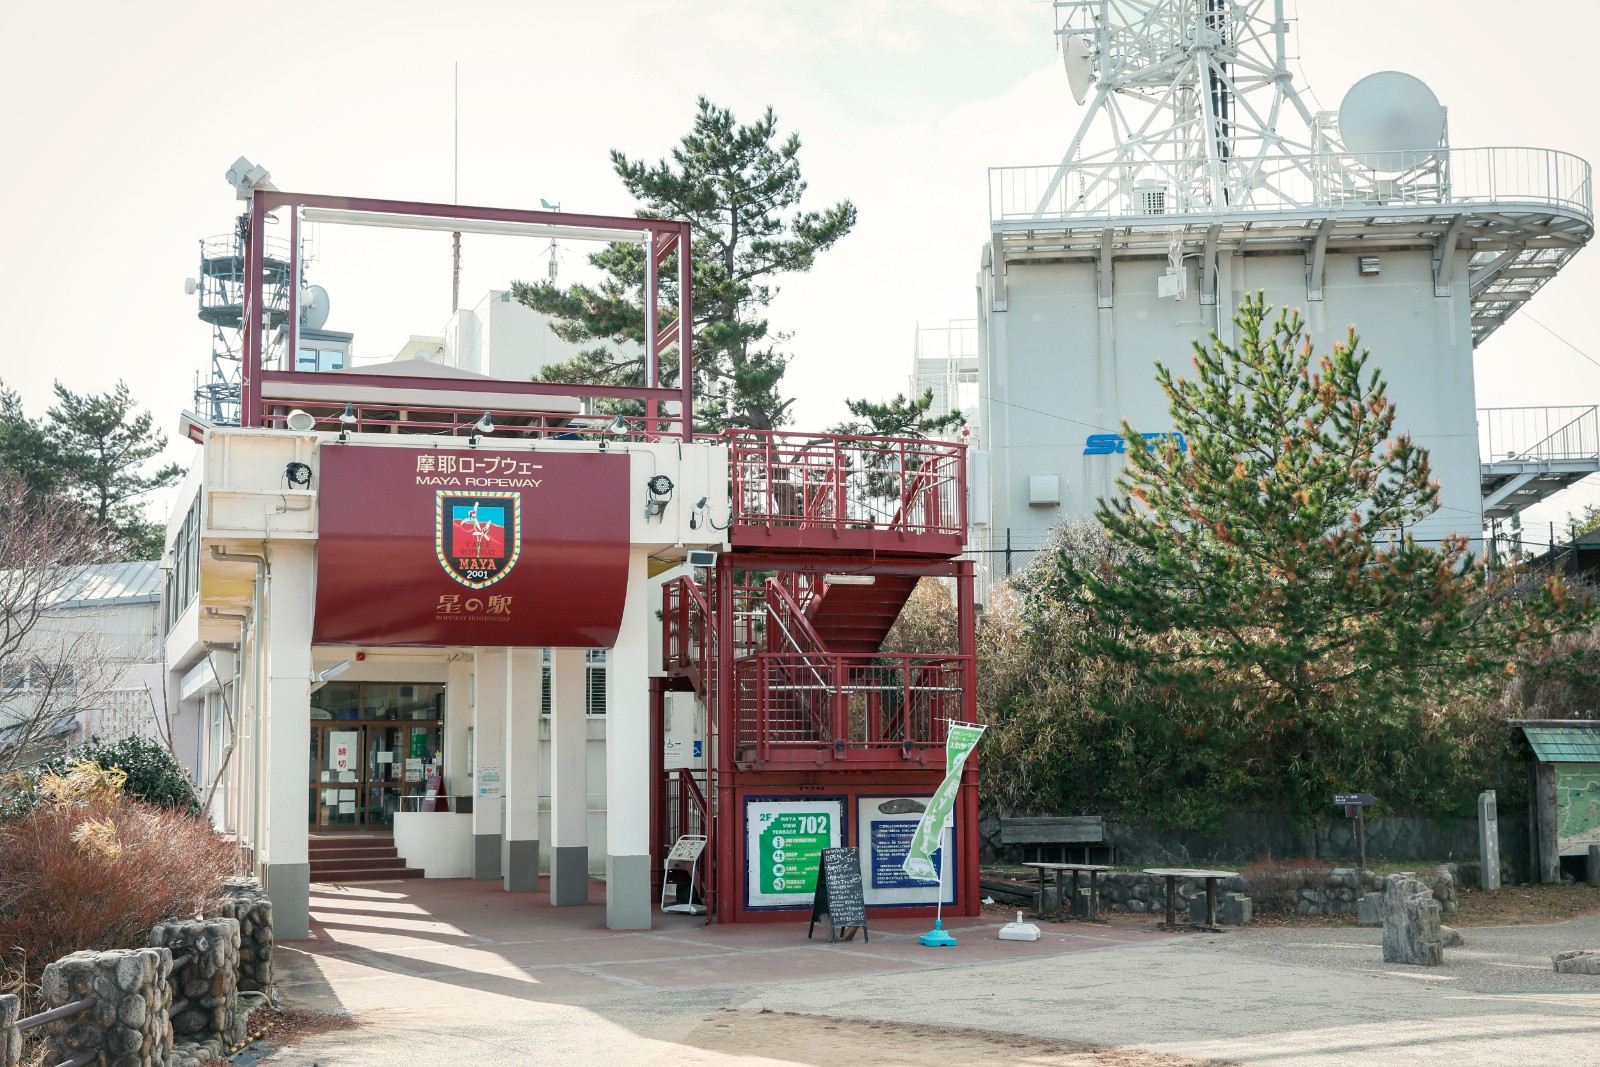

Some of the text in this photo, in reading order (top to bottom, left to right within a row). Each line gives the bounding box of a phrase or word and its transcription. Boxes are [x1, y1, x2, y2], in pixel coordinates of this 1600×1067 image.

[416, 454, 543, 474] 摩耶ロープウェー
[416, 476, 542, 488] MAYA ROPEWAY
[459, 558, 497, 570] MAYA
[466, 570, 488, 579] 2001
[436, 594, 514, 615] 星の駅
[759, 813, 772, 821] 2F
[798, 816, 827, 834] 702
